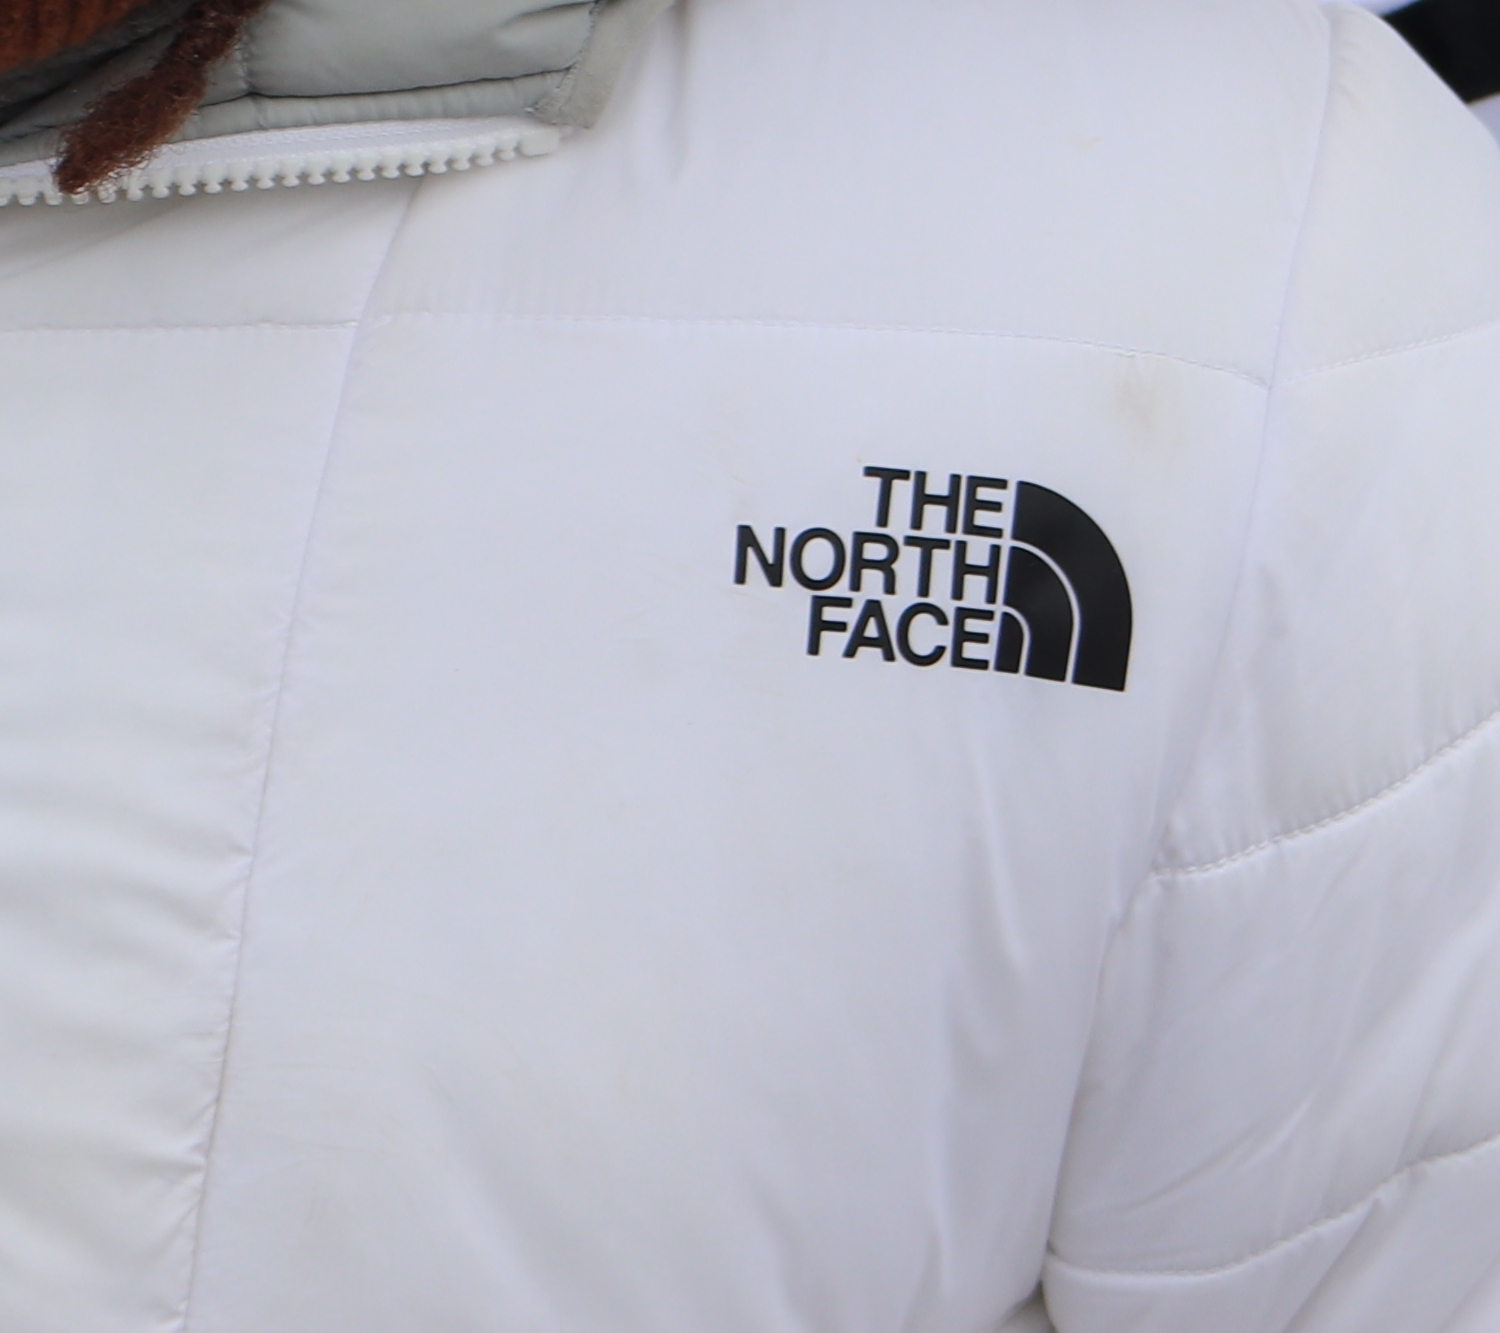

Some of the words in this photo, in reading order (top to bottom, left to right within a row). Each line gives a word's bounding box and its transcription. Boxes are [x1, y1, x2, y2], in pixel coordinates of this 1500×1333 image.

[862, 464, 1008, 540] THE
[733, 523, 1003, 605] NORTH
[806, 593, 997, 671] FACE
